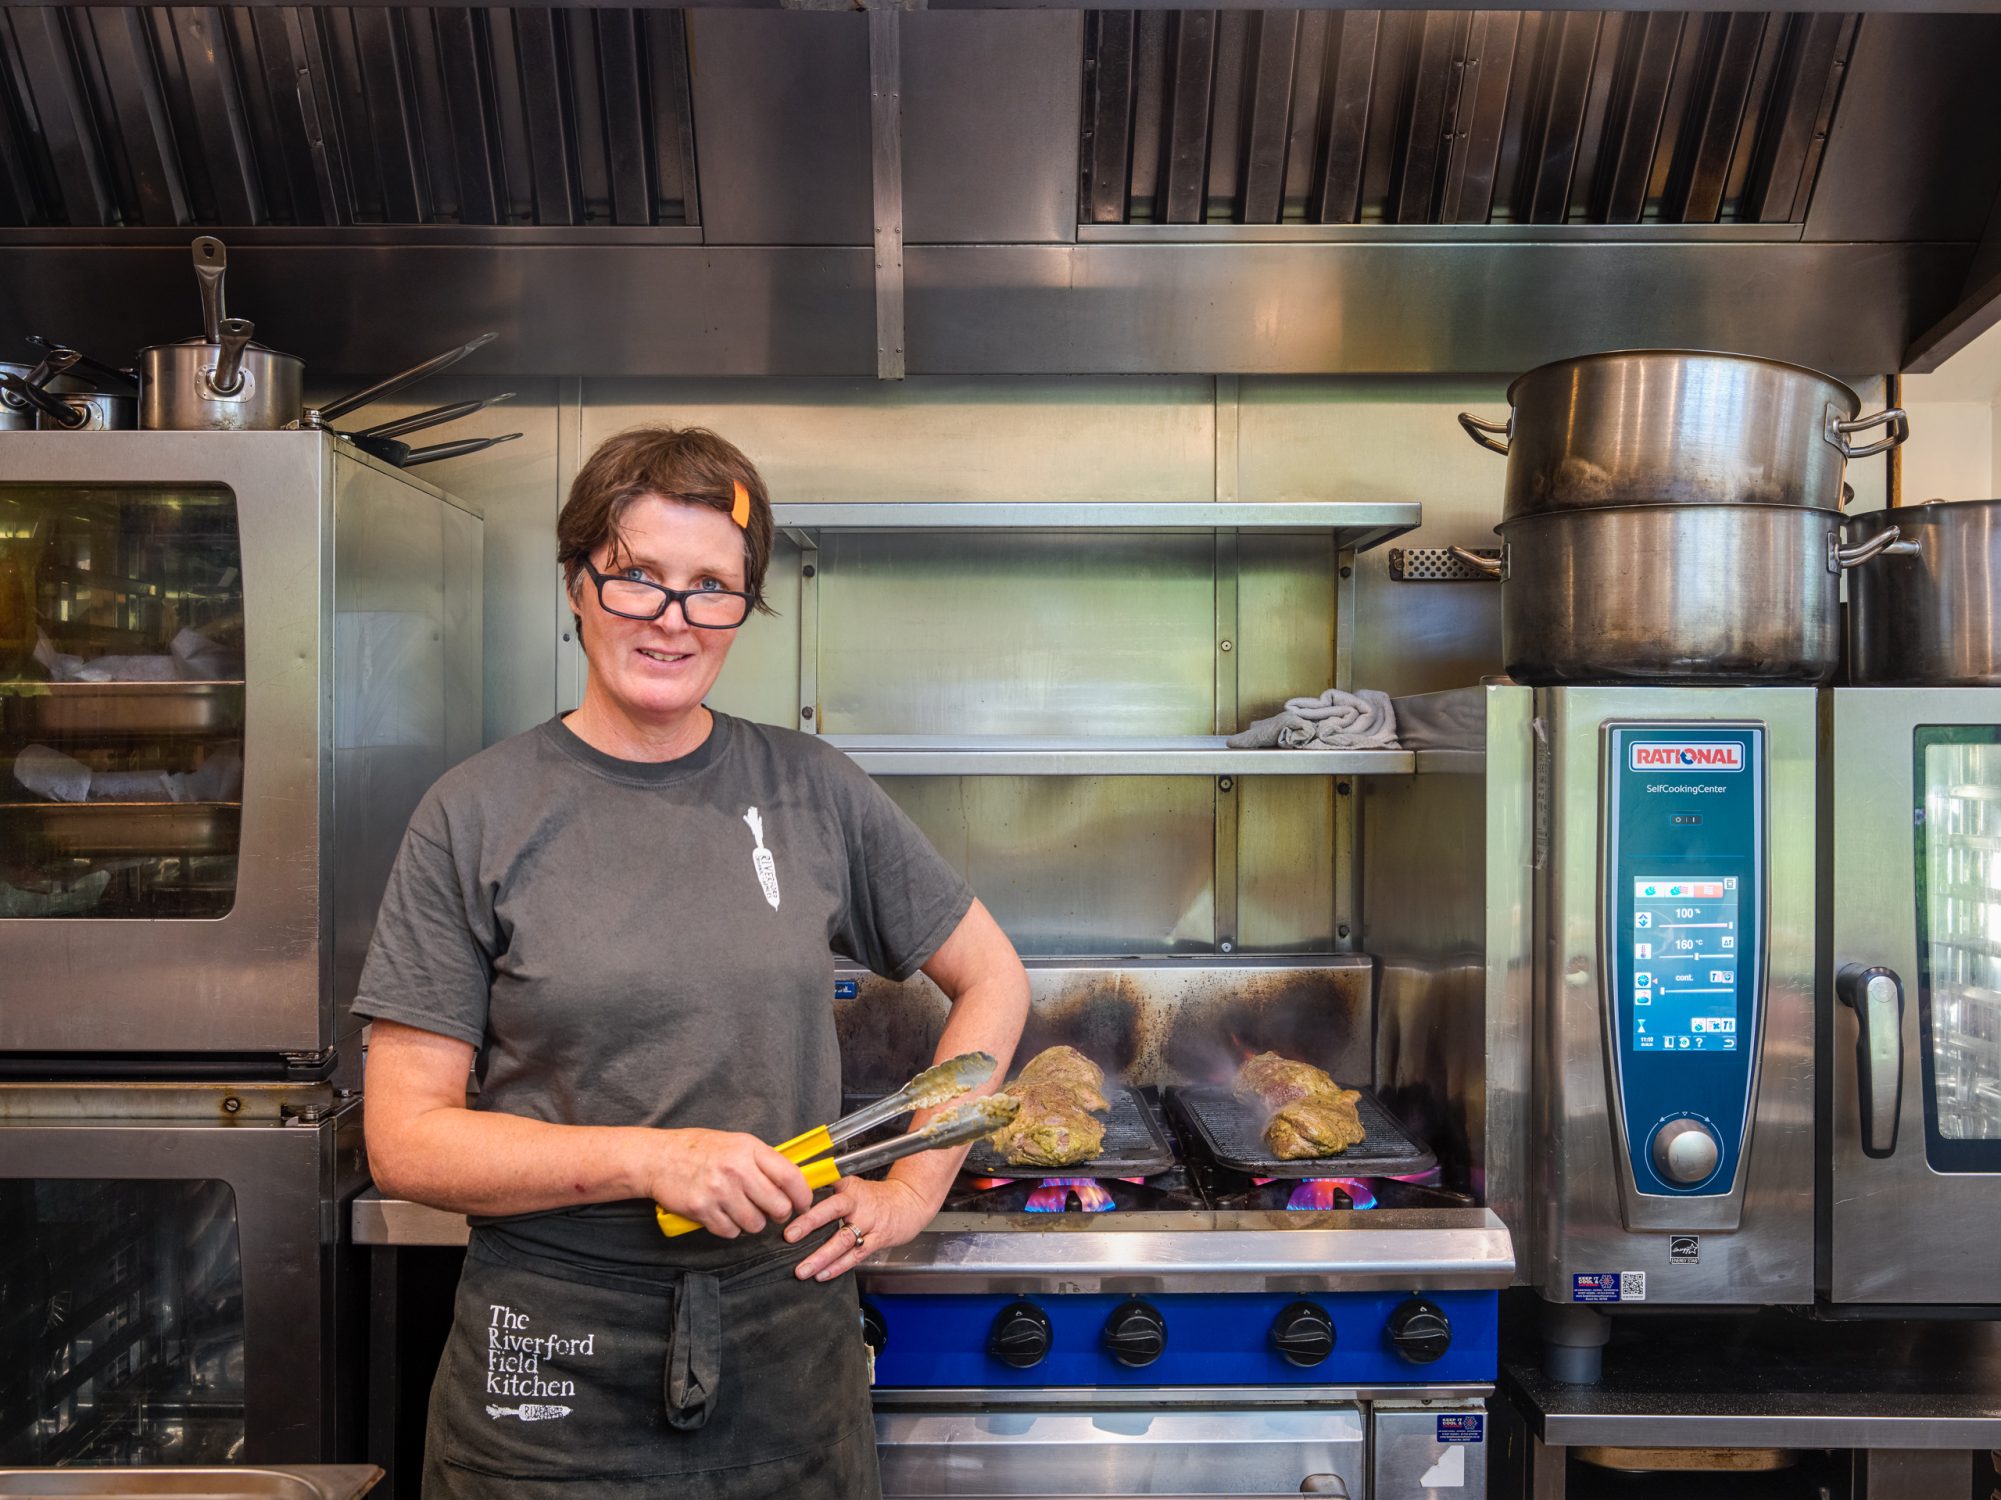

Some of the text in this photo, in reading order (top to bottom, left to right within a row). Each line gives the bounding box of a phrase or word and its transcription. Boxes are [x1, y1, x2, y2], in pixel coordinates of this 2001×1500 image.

[1636, 748, 1739, 765] RATIONAL
[1646, 784, 1727, 795] SelfCookingCenter
[1675, 908, 1694, 918] 100
[1675, 939, 1694, 950] 160
[1675, 974, 1694, 982] cont.
[490, 1304, 530, 1330] The
[488, 1327, 595, 1361] Riverford
[488, 1349, 539, 1374] Field
[486, 1371, 576, 1397] Kitchen
